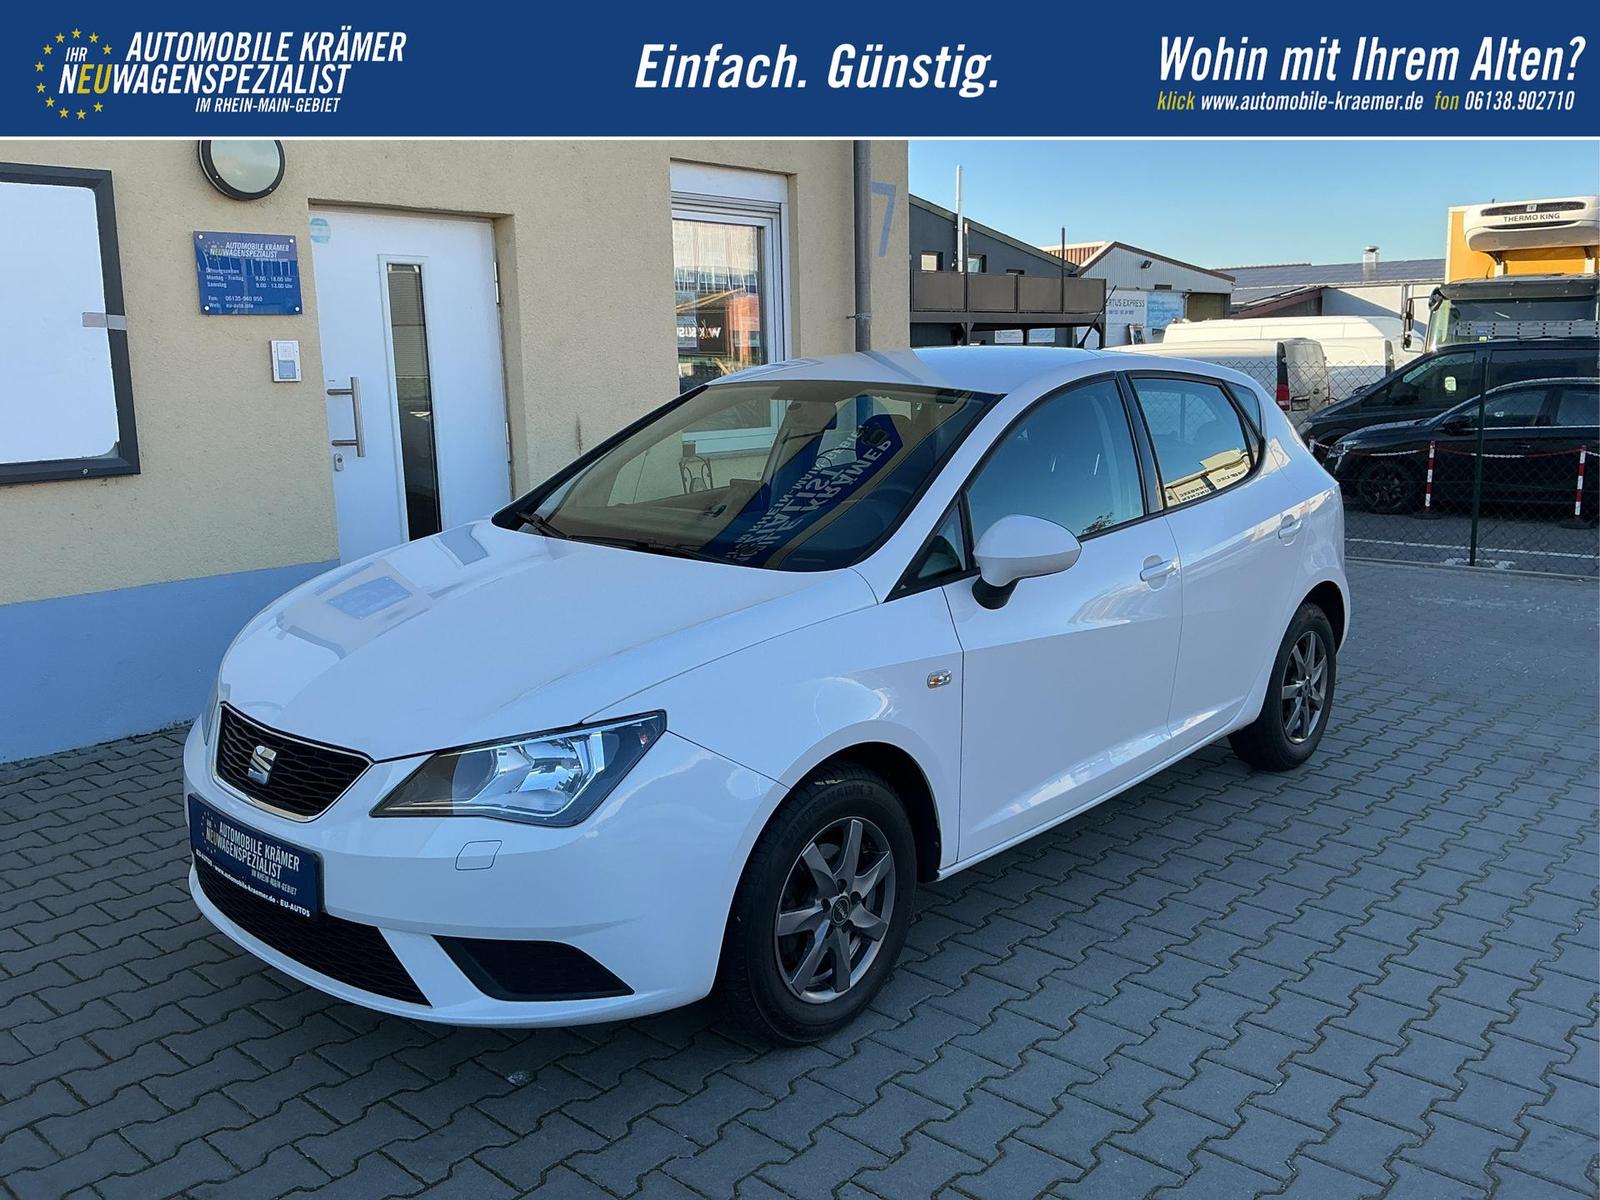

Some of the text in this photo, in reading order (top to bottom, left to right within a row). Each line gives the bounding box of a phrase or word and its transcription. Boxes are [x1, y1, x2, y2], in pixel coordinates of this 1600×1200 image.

[871, 181, 896, 257] 7
[1503, 212, 1561, 223] THERMO KING
[225, 241, 264, 250] AUTOMOBILE
[264, 242, 290, 252] KRÄMER
[1122, 299, 1145, 308] EXPRESS
[206, 826, 282, 879] NEUWAGENSPEZIALIST
[219, 821, 300, 872] AUTOMOBILE KRÄMER
[280, 898, 311, 918] EU-AUTOS
